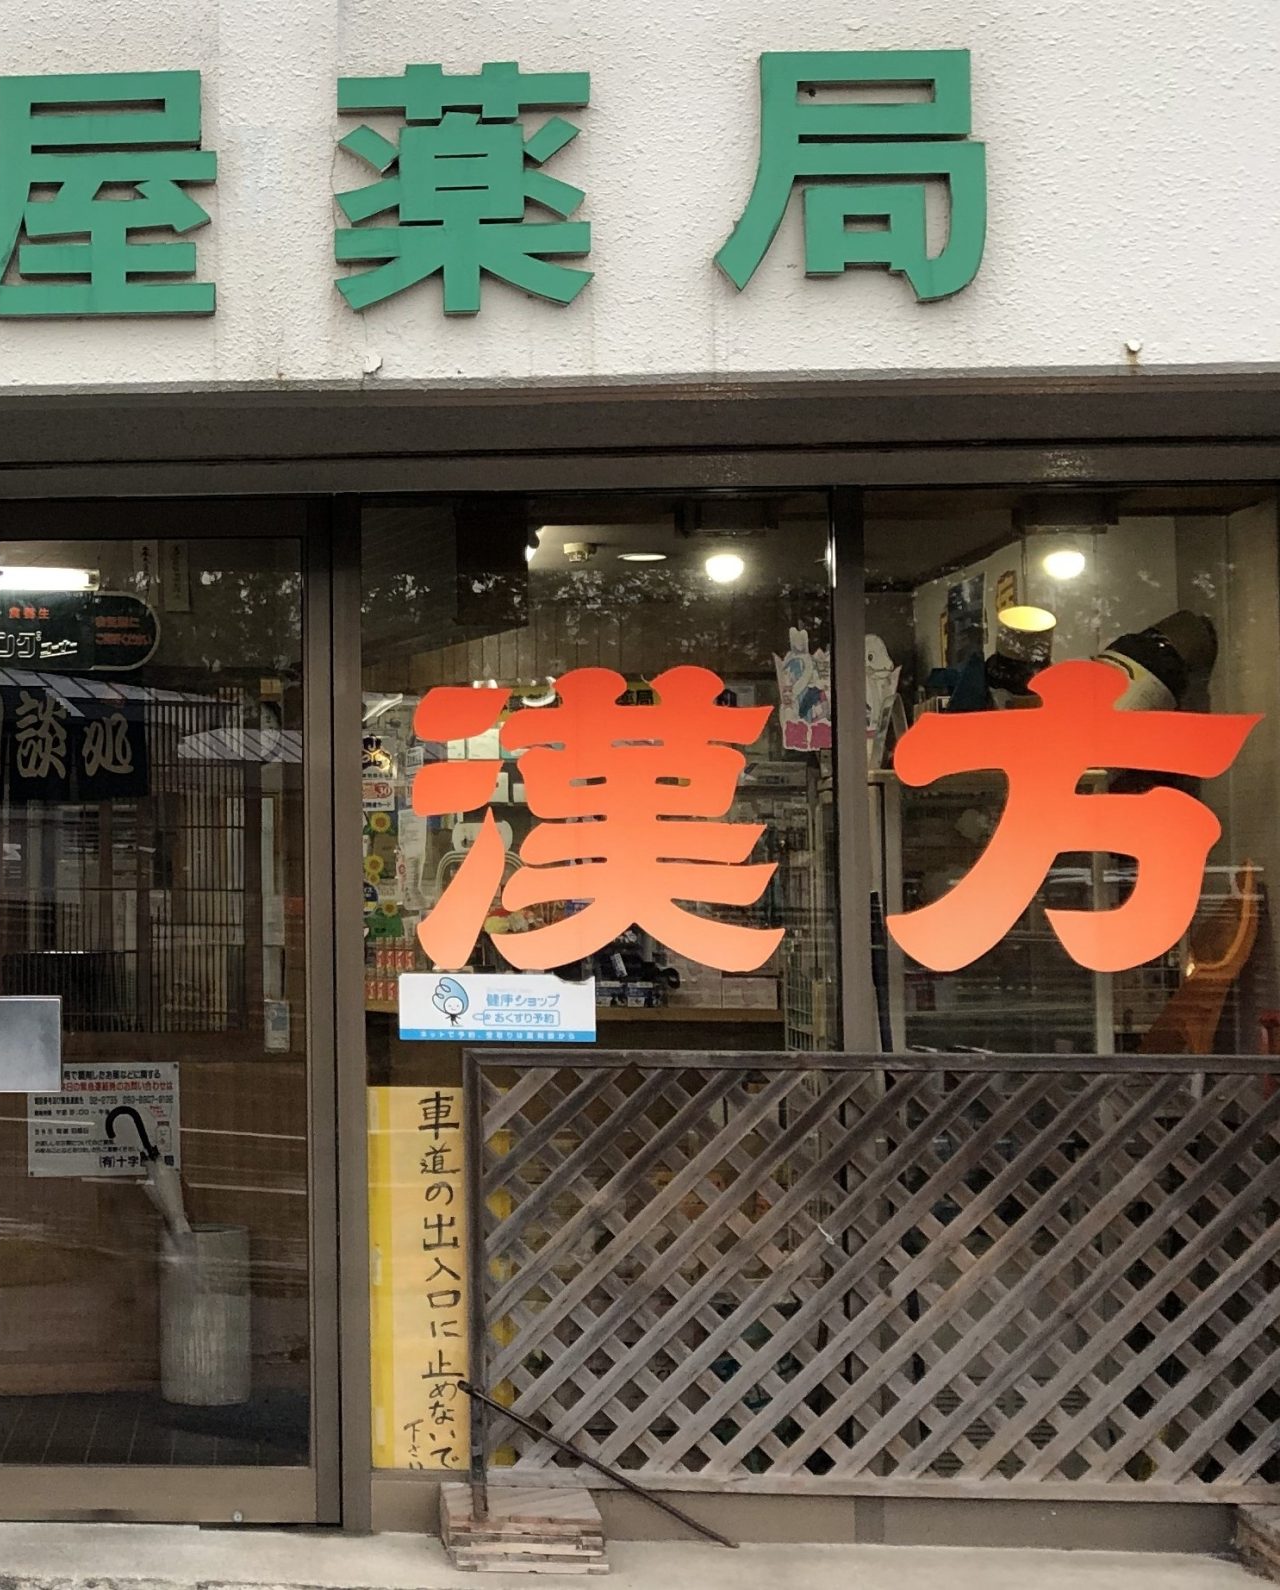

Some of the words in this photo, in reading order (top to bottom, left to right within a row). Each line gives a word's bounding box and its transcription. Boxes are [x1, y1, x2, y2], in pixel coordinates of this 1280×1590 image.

[412, 659, 1265, 973] 漢方
[494, 1012, 555, 1024] おくすり予約
[417, 1090, 466, 1470] 車道の出入口に止めないで
